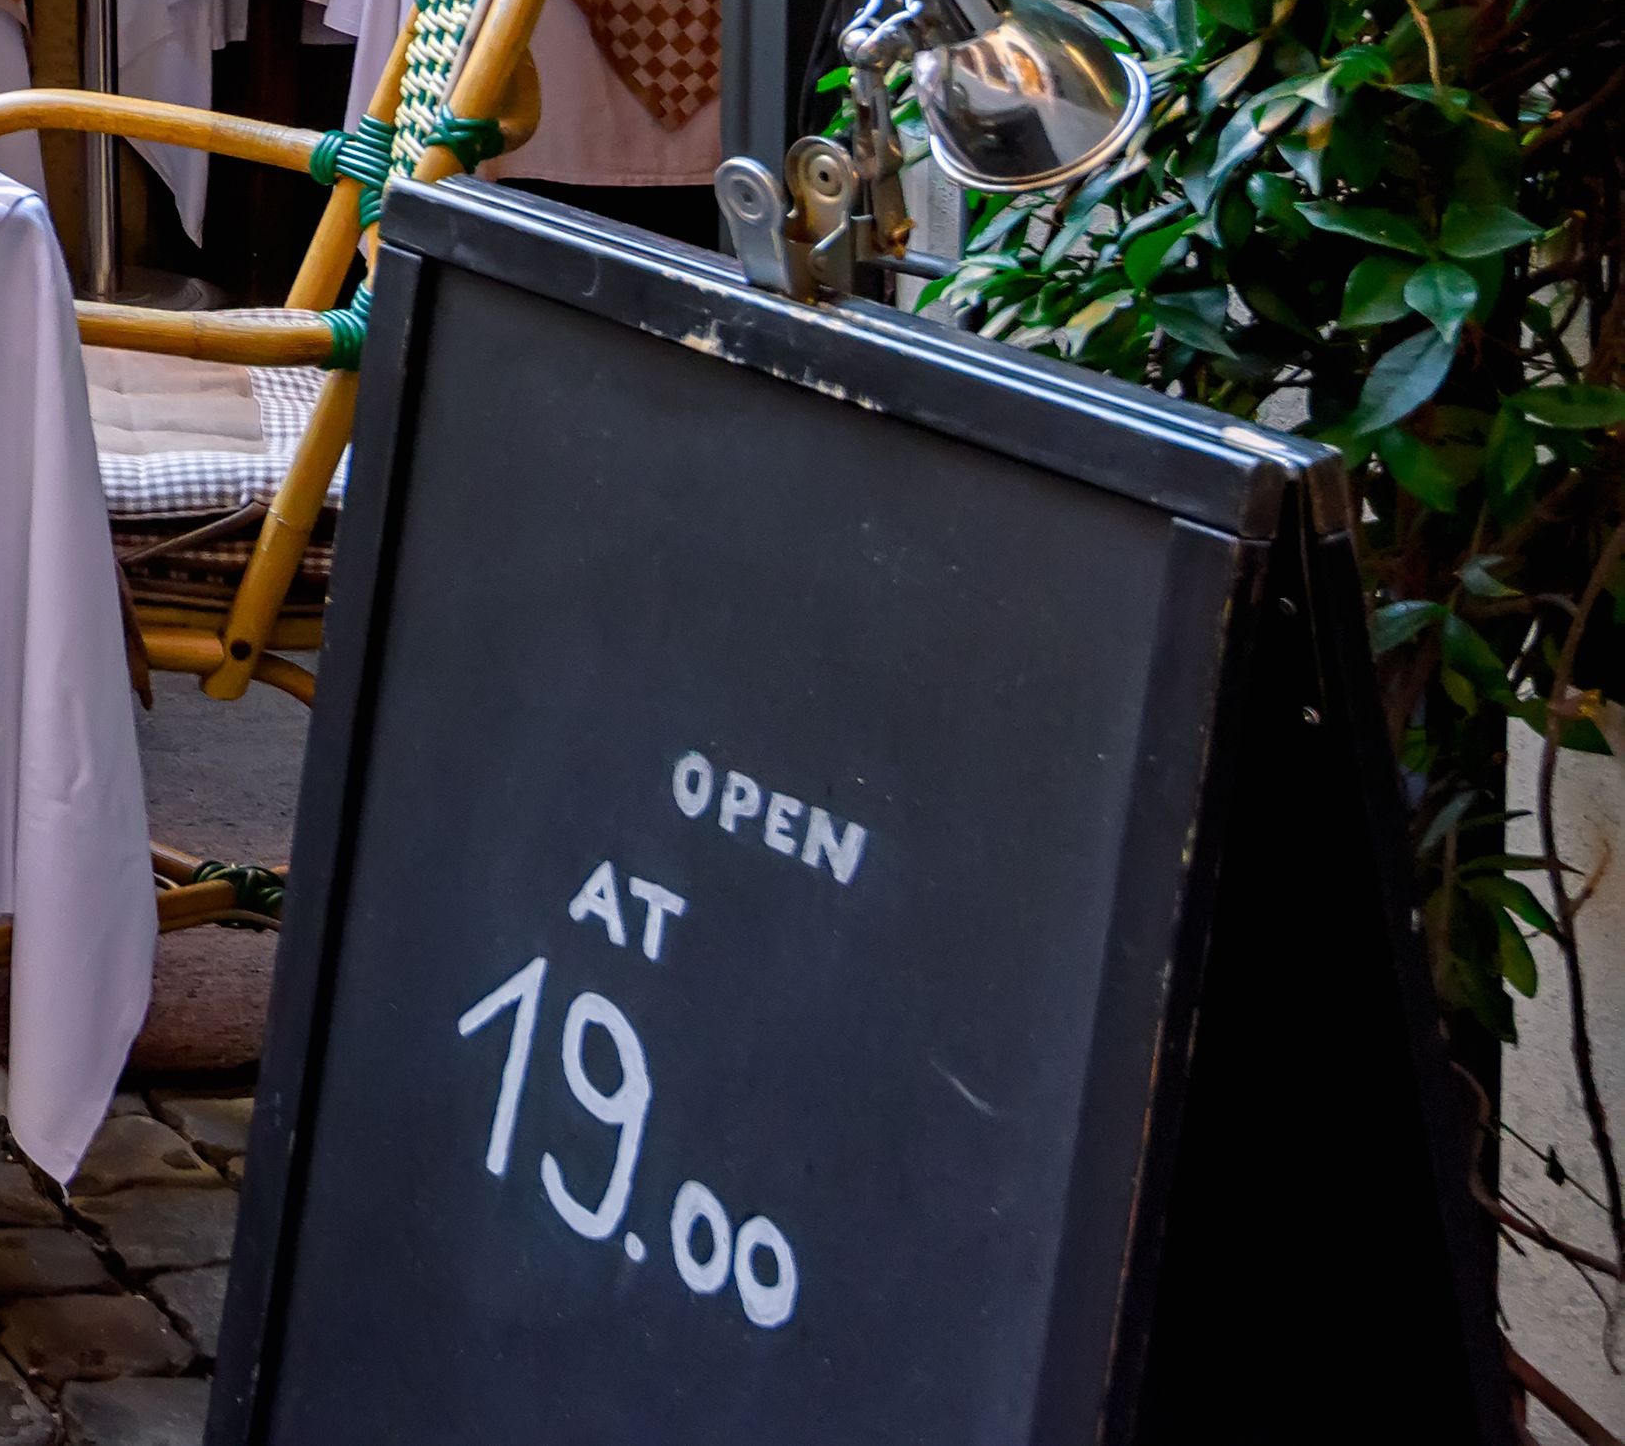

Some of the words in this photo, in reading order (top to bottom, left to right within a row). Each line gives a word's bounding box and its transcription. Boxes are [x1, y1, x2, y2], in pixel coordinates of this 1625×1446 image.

[672, 751, 868, 884] OPEN
[569, 860, 686, 961] AT
[458, 957, 798, 1328] 19.00
